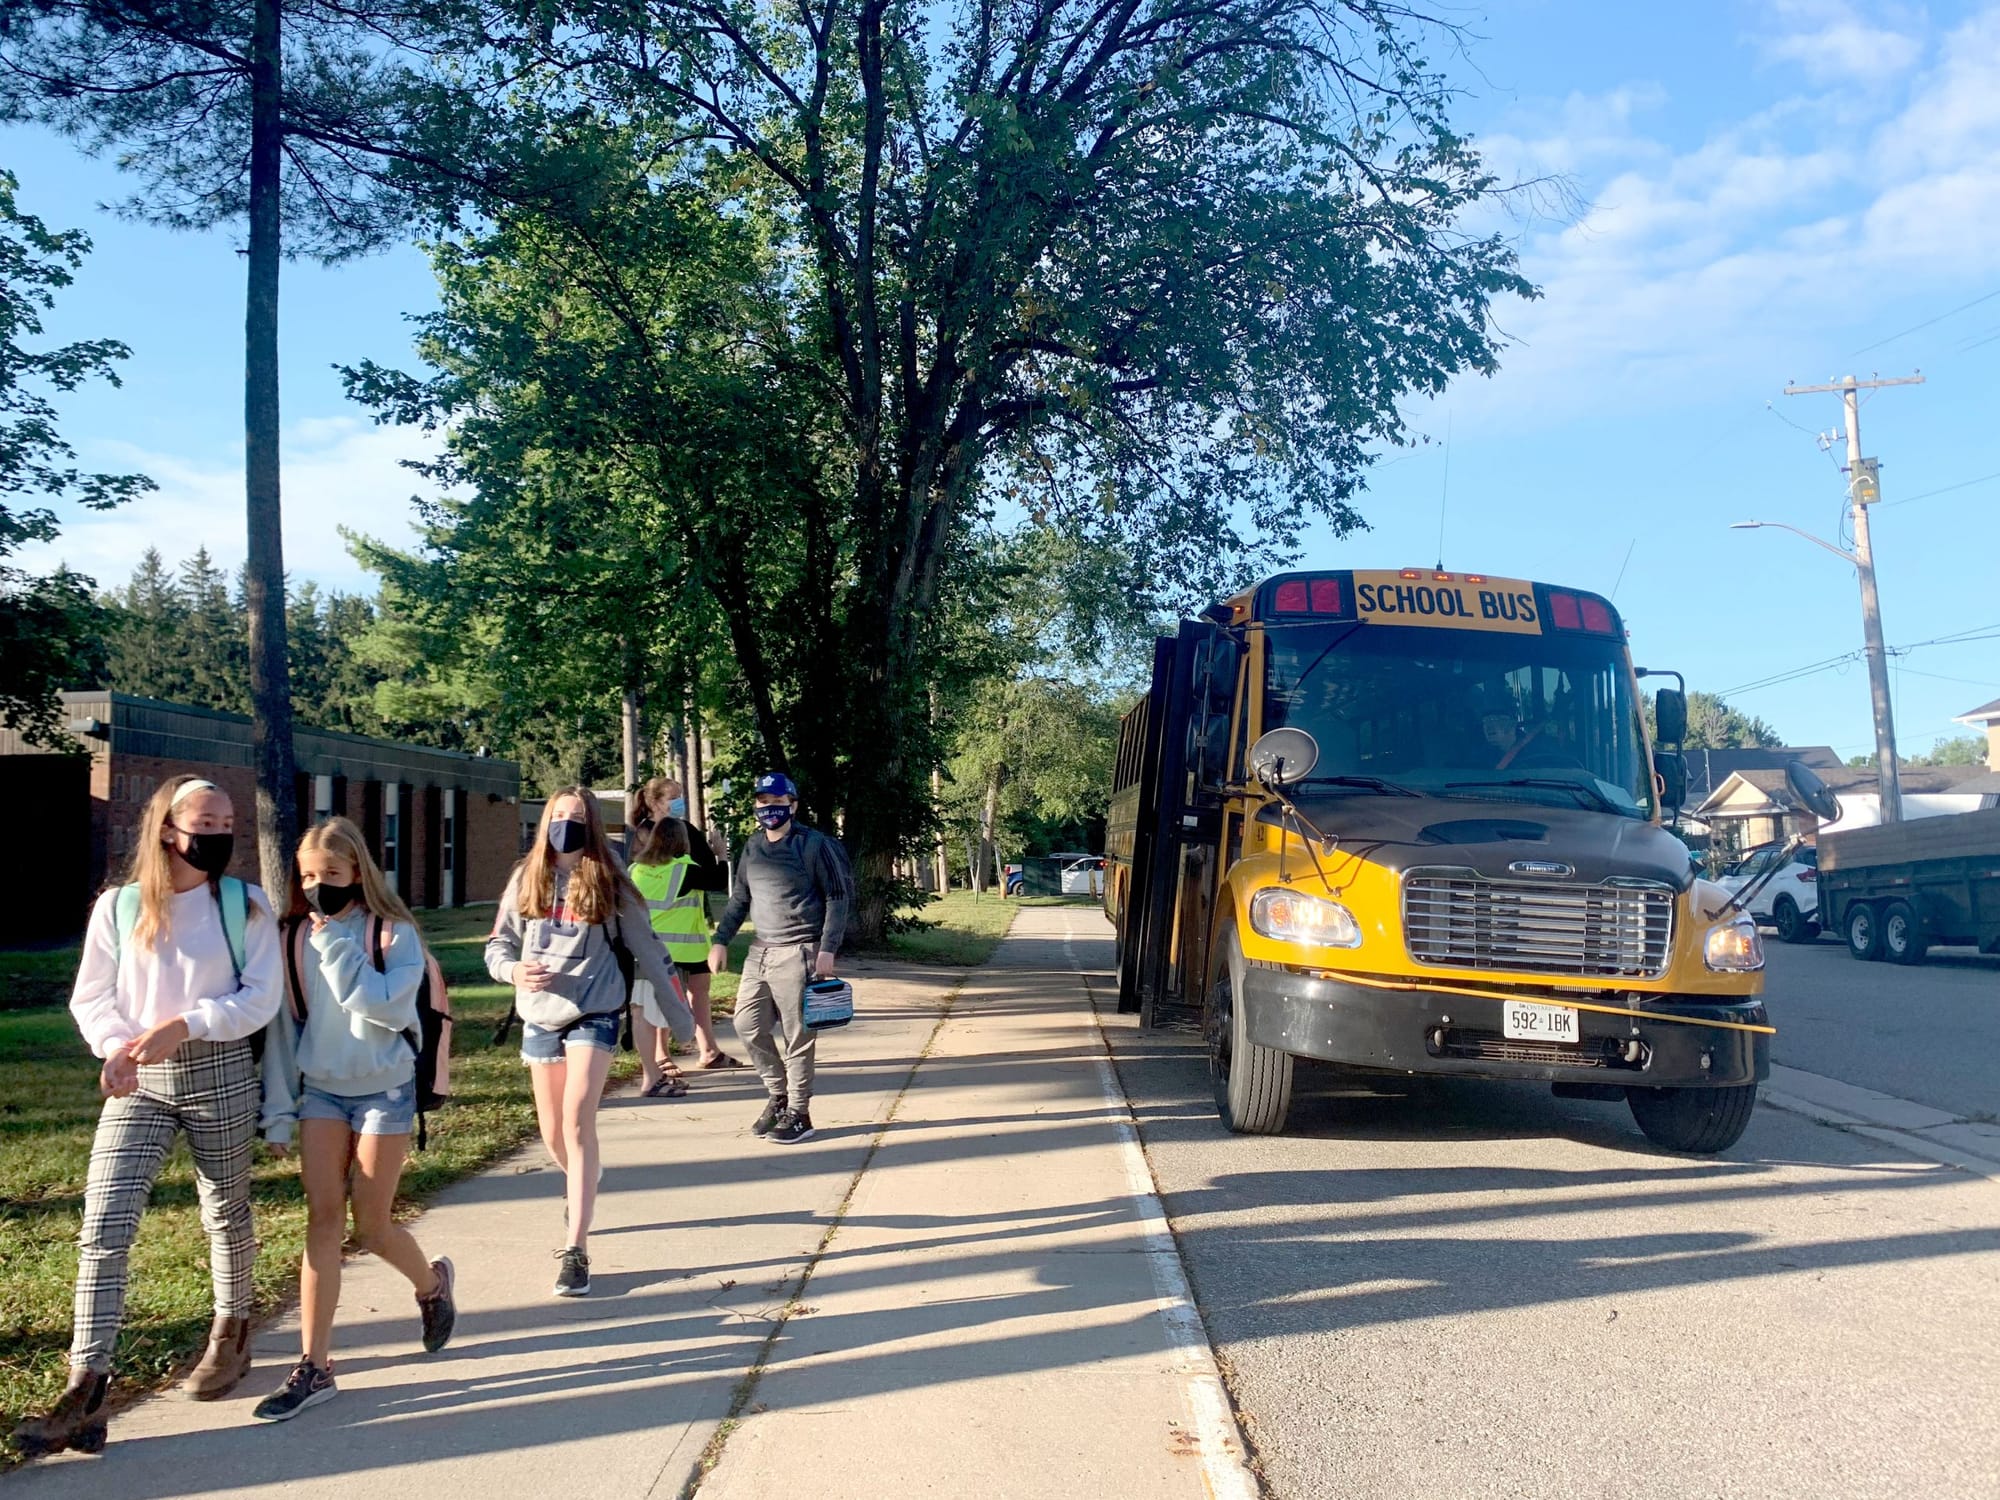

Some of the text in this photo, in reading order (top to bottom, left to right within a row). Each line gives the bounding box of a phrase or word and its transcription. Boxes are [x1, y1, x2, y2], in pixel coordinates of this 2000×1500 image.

[1358, 584, 1536, 622] SCHOOL BUS
[1512, 1011, 1571, 1032] 592 1BK
